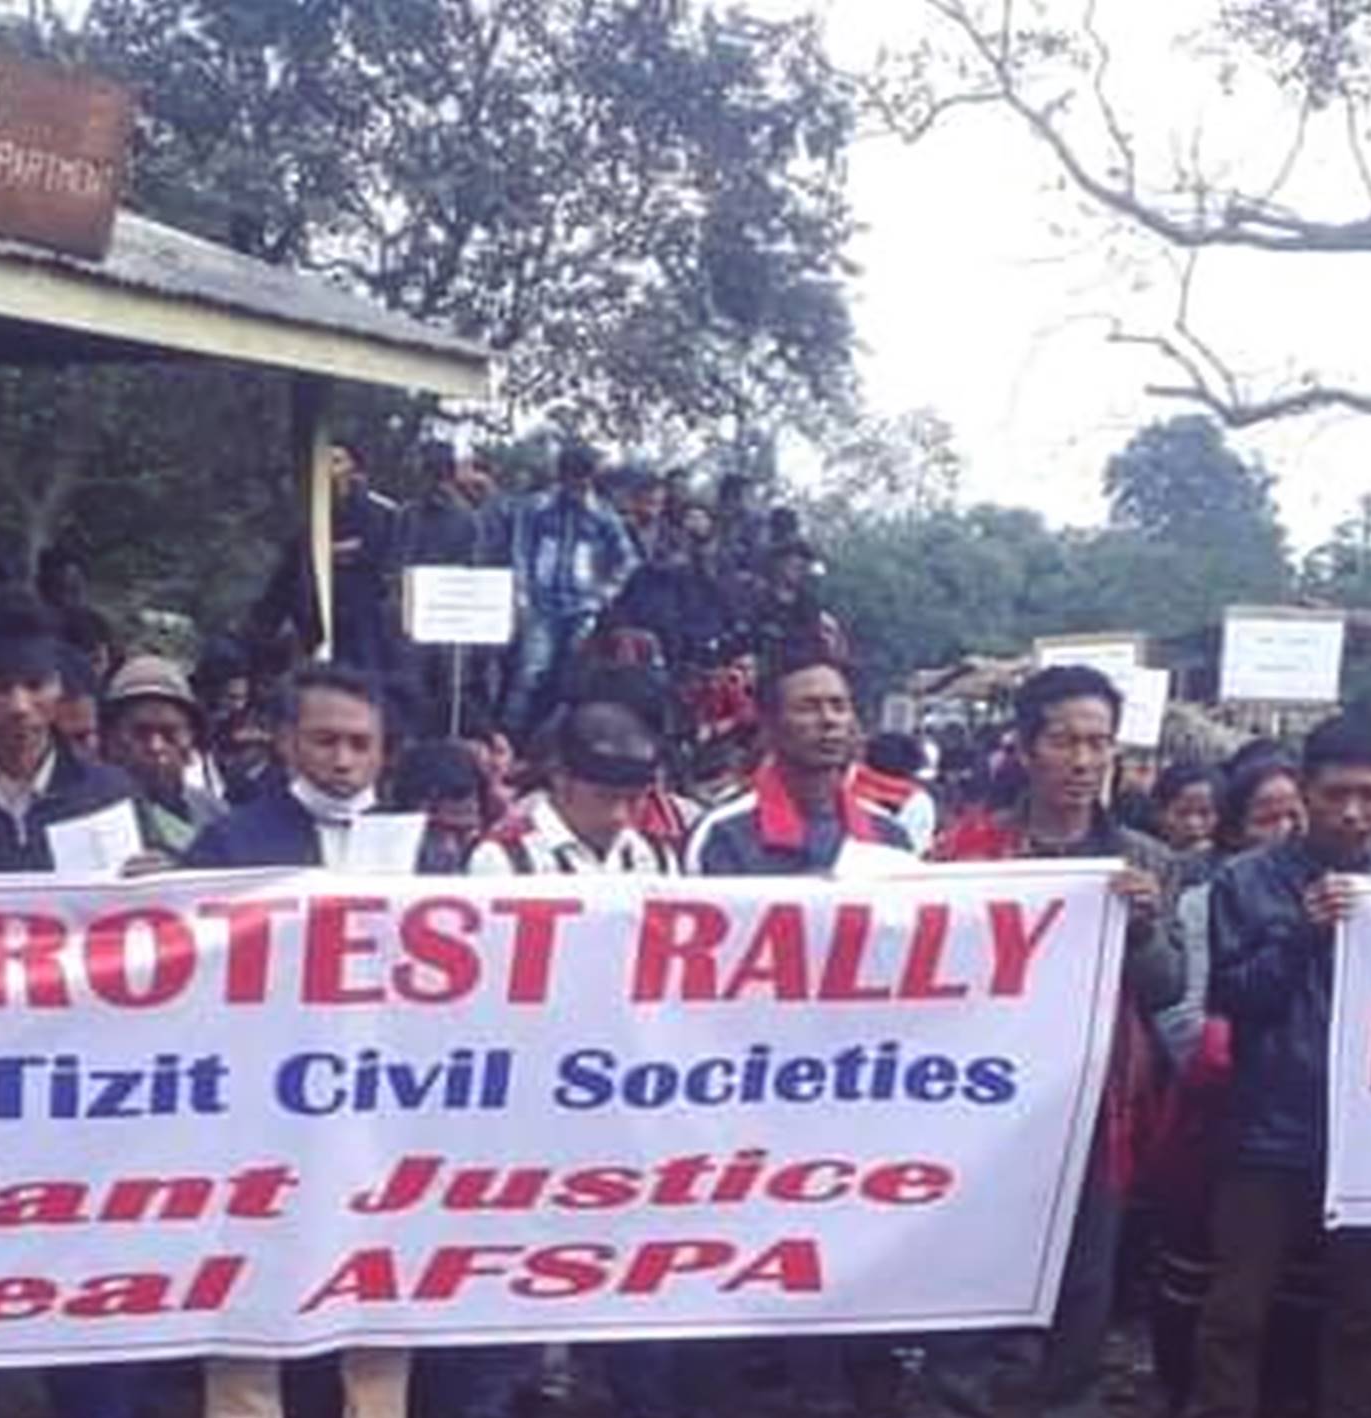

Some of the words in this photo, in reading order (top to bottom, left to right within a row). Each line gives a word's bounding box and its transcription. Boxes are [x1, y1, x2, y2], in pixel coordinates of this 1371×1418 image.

[630, 897, 1066, 1006] RALLY
[274, 1048, 512, 1116] Civil
[554, 1042, 1018, 1110] Societies
[346, 1149, 955, 1216] Justice
[296, 1239, 825, 1315] AFSPA
